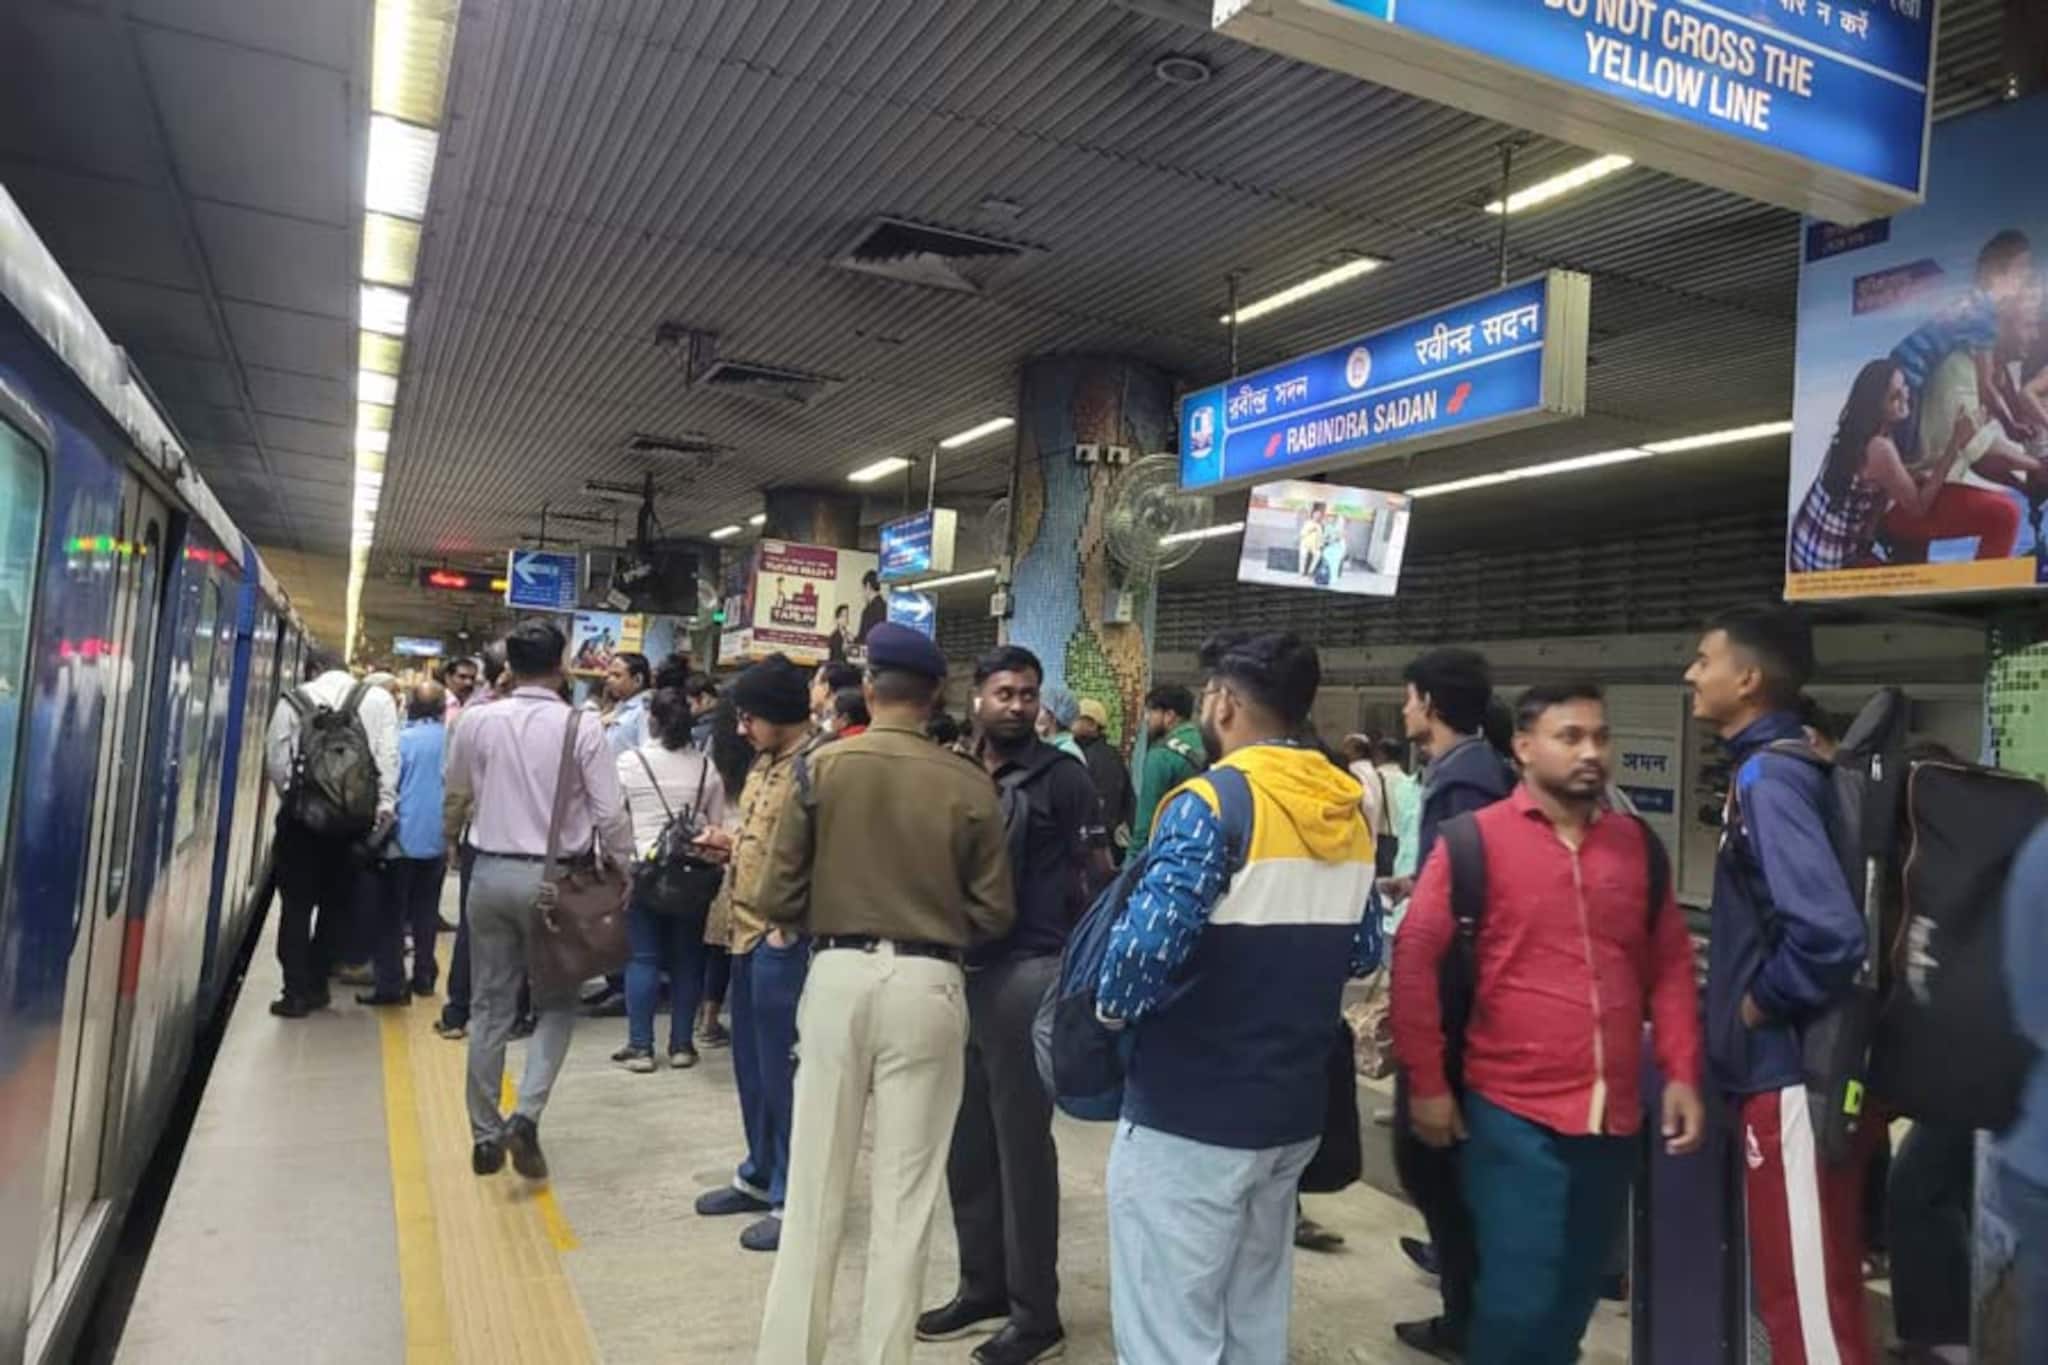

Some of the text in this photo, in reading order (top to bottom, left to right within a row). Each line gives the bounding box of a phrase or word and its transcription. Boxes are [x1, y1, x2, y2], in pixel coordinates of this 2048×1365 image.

[1595, 0, 1658, 40] NOT
[1661, 7, 1756, 77] CROSS
[1763, 44, 1814, 98] THE
[1816, 1, 1832, 26] न
[1839, 9, 1869, 40] करें
[1585, 31, 1772, 131] YELLOW LINE
[1414, 300, 1540, 366] रवीन्द्र सदन
[1286, 390, 1437, 454] RABINDRA SADAN
